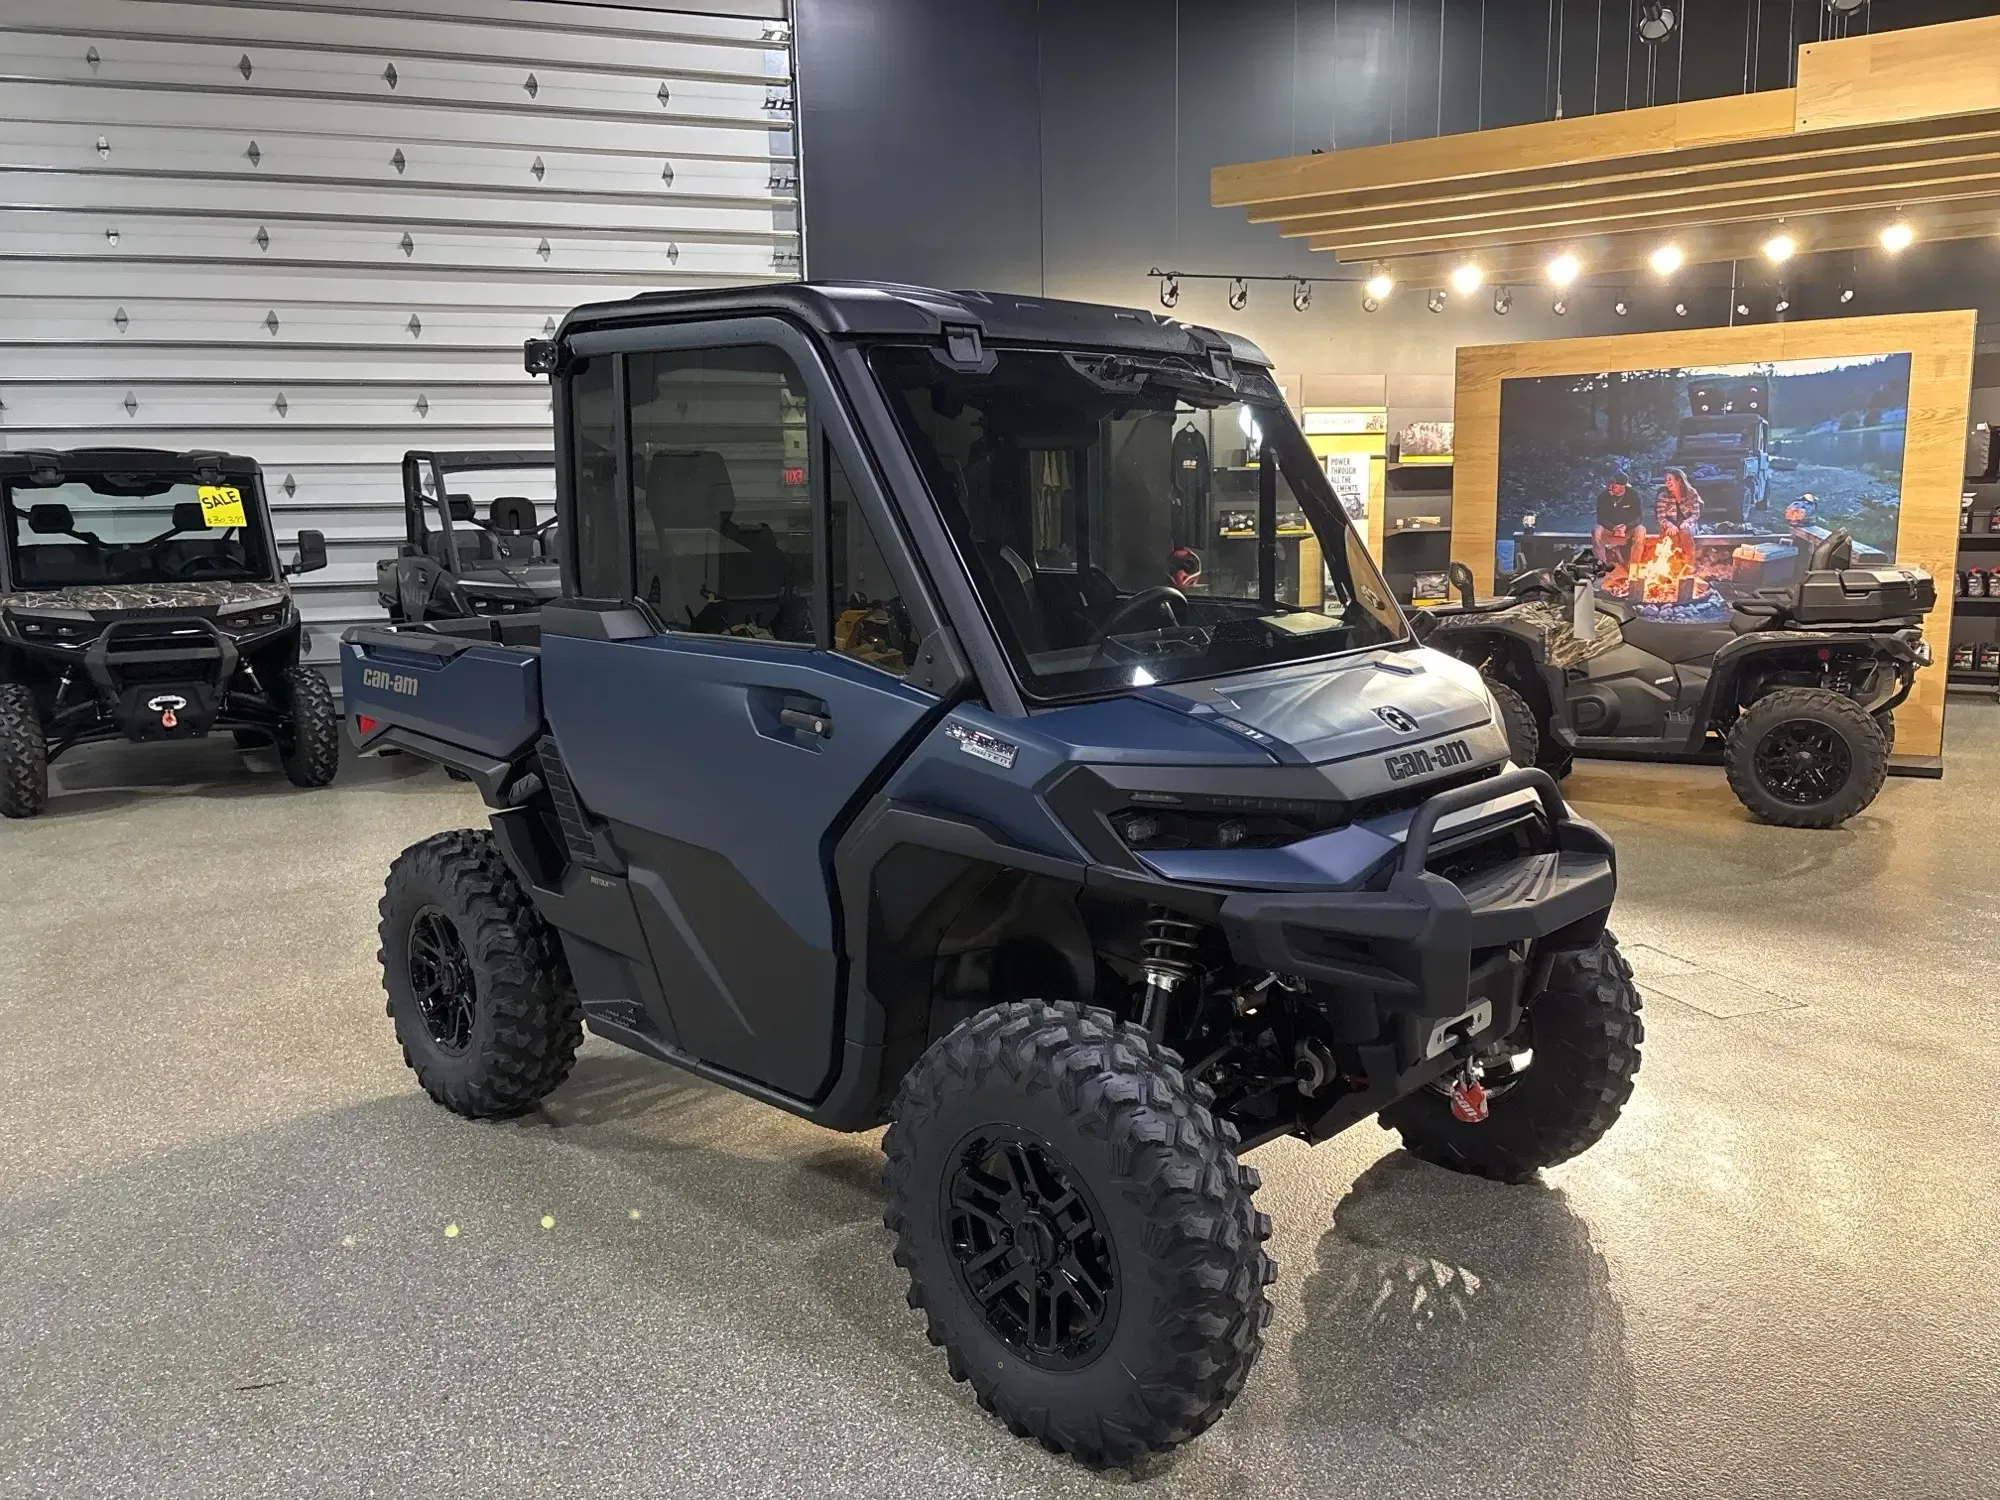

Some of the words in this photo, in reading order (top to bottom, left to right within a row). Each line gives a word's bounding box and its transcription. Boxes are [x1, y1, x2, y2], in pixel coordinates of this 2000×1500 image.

[1330, 457, 1351, 466] POWER
[1331, 467, 1357, 475] THROUGH
[1331, 476, 1341, 484] ALL
[1341, 476, 1352, 484] THE
[1334, 484, 1359, 493] EMENTS
[201, 490, 240, 510] SALE
[363, 668, 419, 697] can-am
[1384, 739, 1474, 782] can-am
